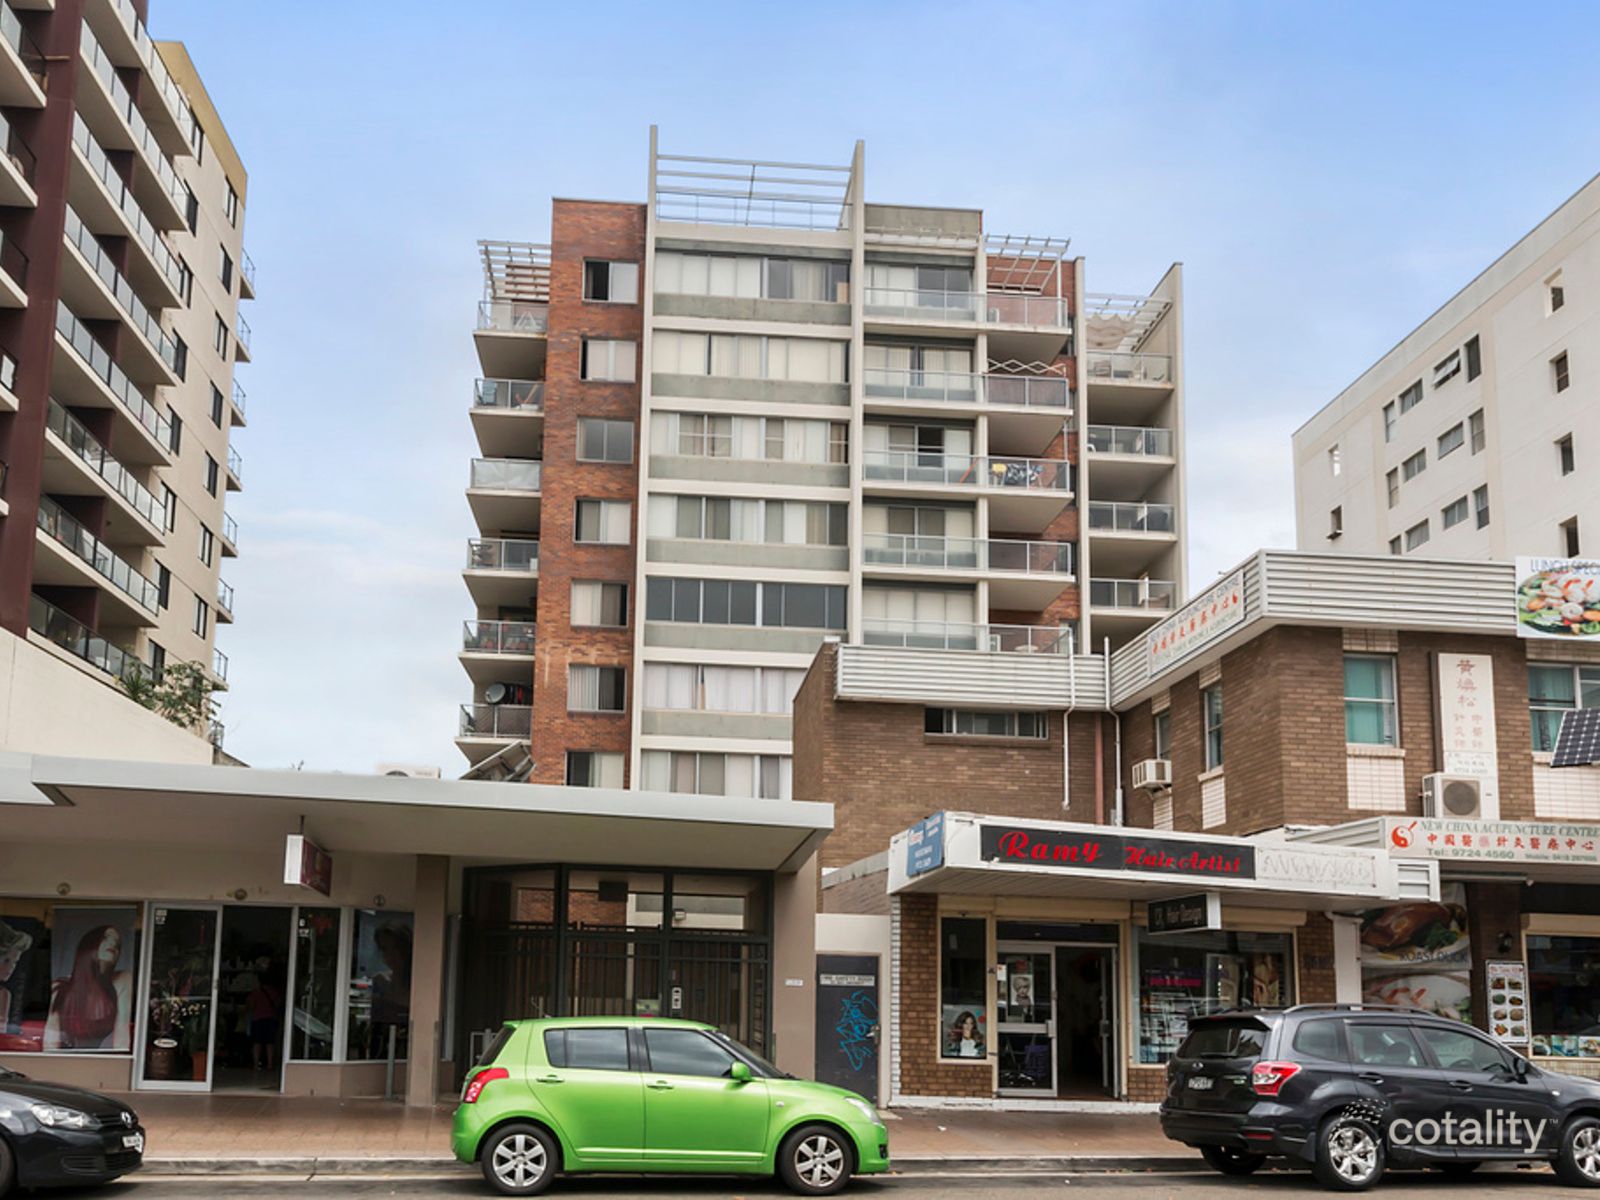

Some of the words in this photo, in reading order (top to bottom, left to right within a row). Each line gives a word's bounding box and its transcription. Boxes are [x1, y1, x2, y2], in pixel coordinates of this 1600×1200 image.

[1421, 821, 1442, 832] NEW
[1446, 822, 1478, 833] CHINA
[1480, 822, 1556, 836] ACUPUNCTURE
[1559, 825, 1600, 837] CENTRE
[999, 831, 1104, 863] Ramy
[1123, 846, 1175, 868] Hair
[1178, 851, 1241, 873] Artist
[1451, 848, 1482, 858] 9724
